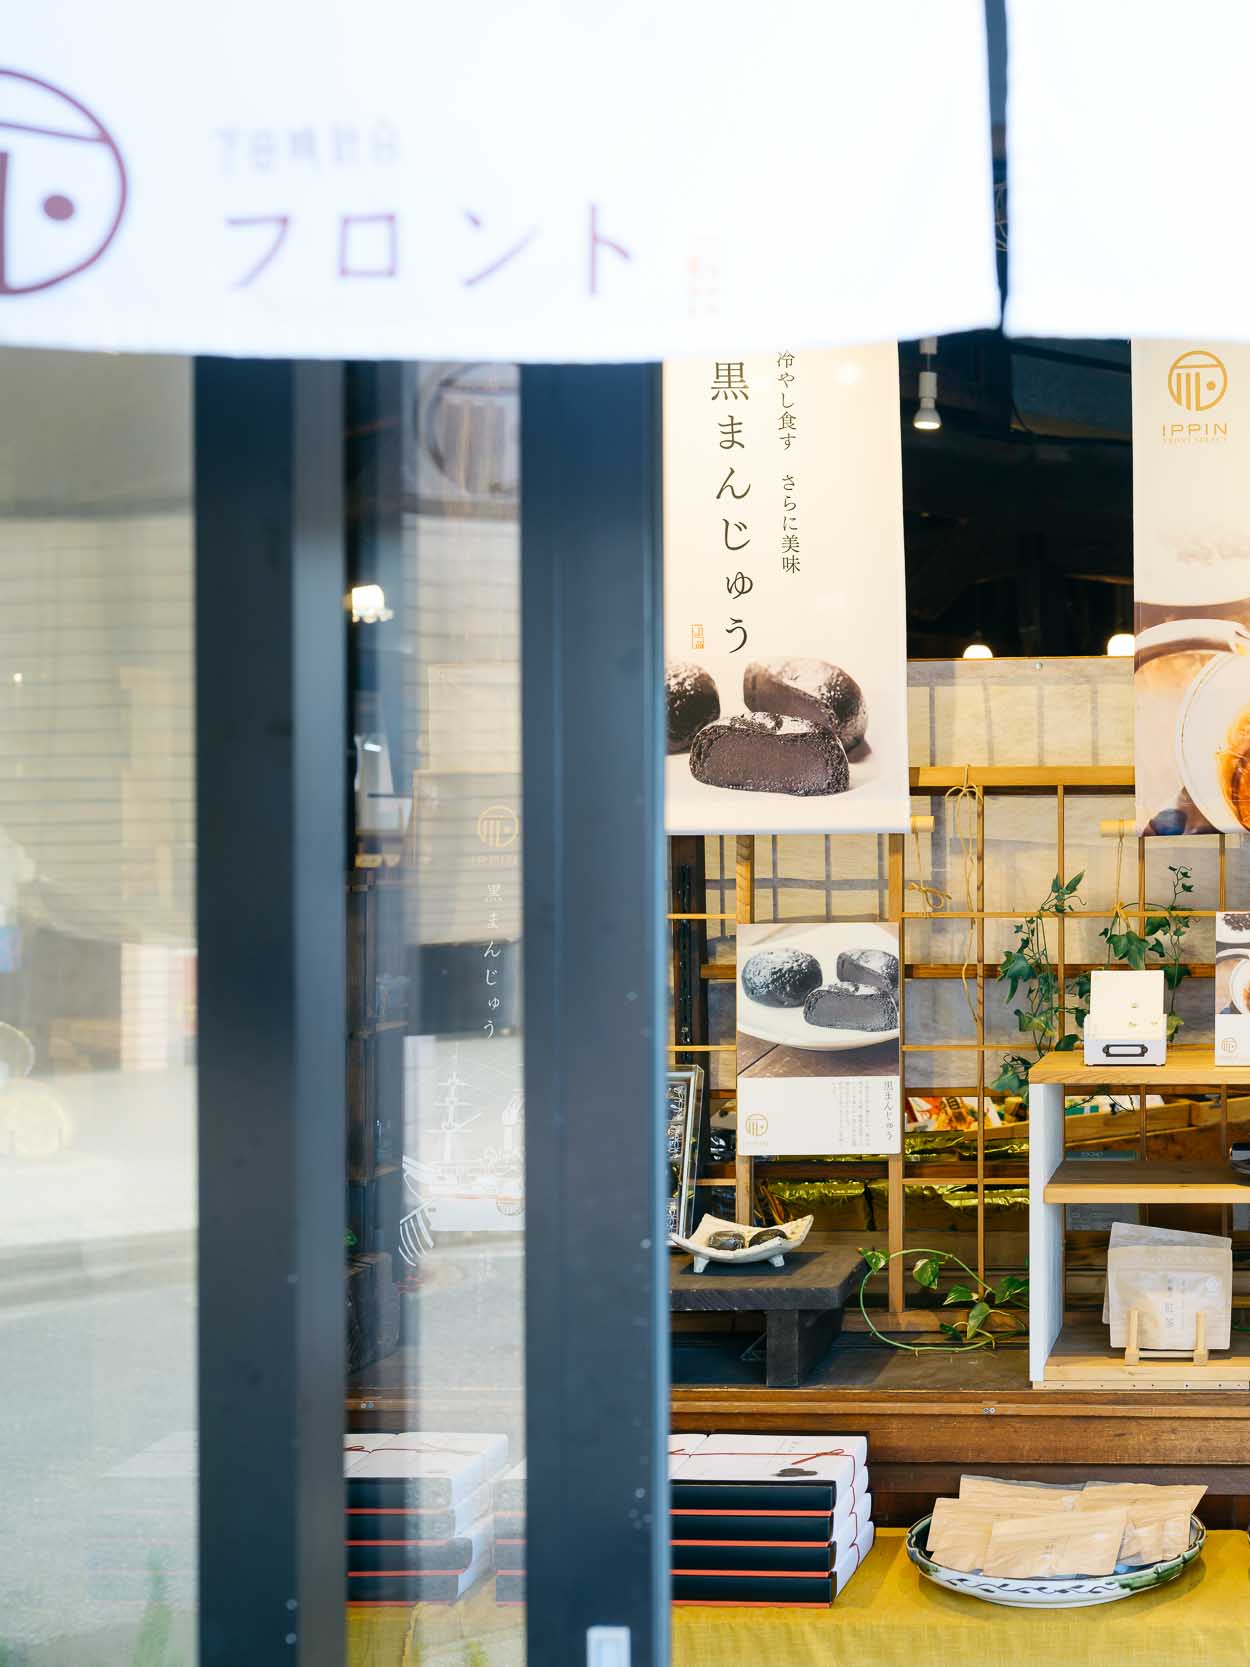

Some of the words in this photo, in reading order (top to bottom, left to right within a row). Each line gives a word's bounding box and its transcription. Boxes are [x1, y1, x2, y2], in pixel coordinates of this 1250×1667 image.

[225, 201, 634, 298] フロント
[775, 349, 797, 452] 冷やし食す
[1161, 423, 1228, 437] IPPIN
[709, 361, 754, 655] 黒まんじゅう
[780, 474, 801, 575] さらに美味
[483, 883, 504, 1041] 黒まんじゅう
